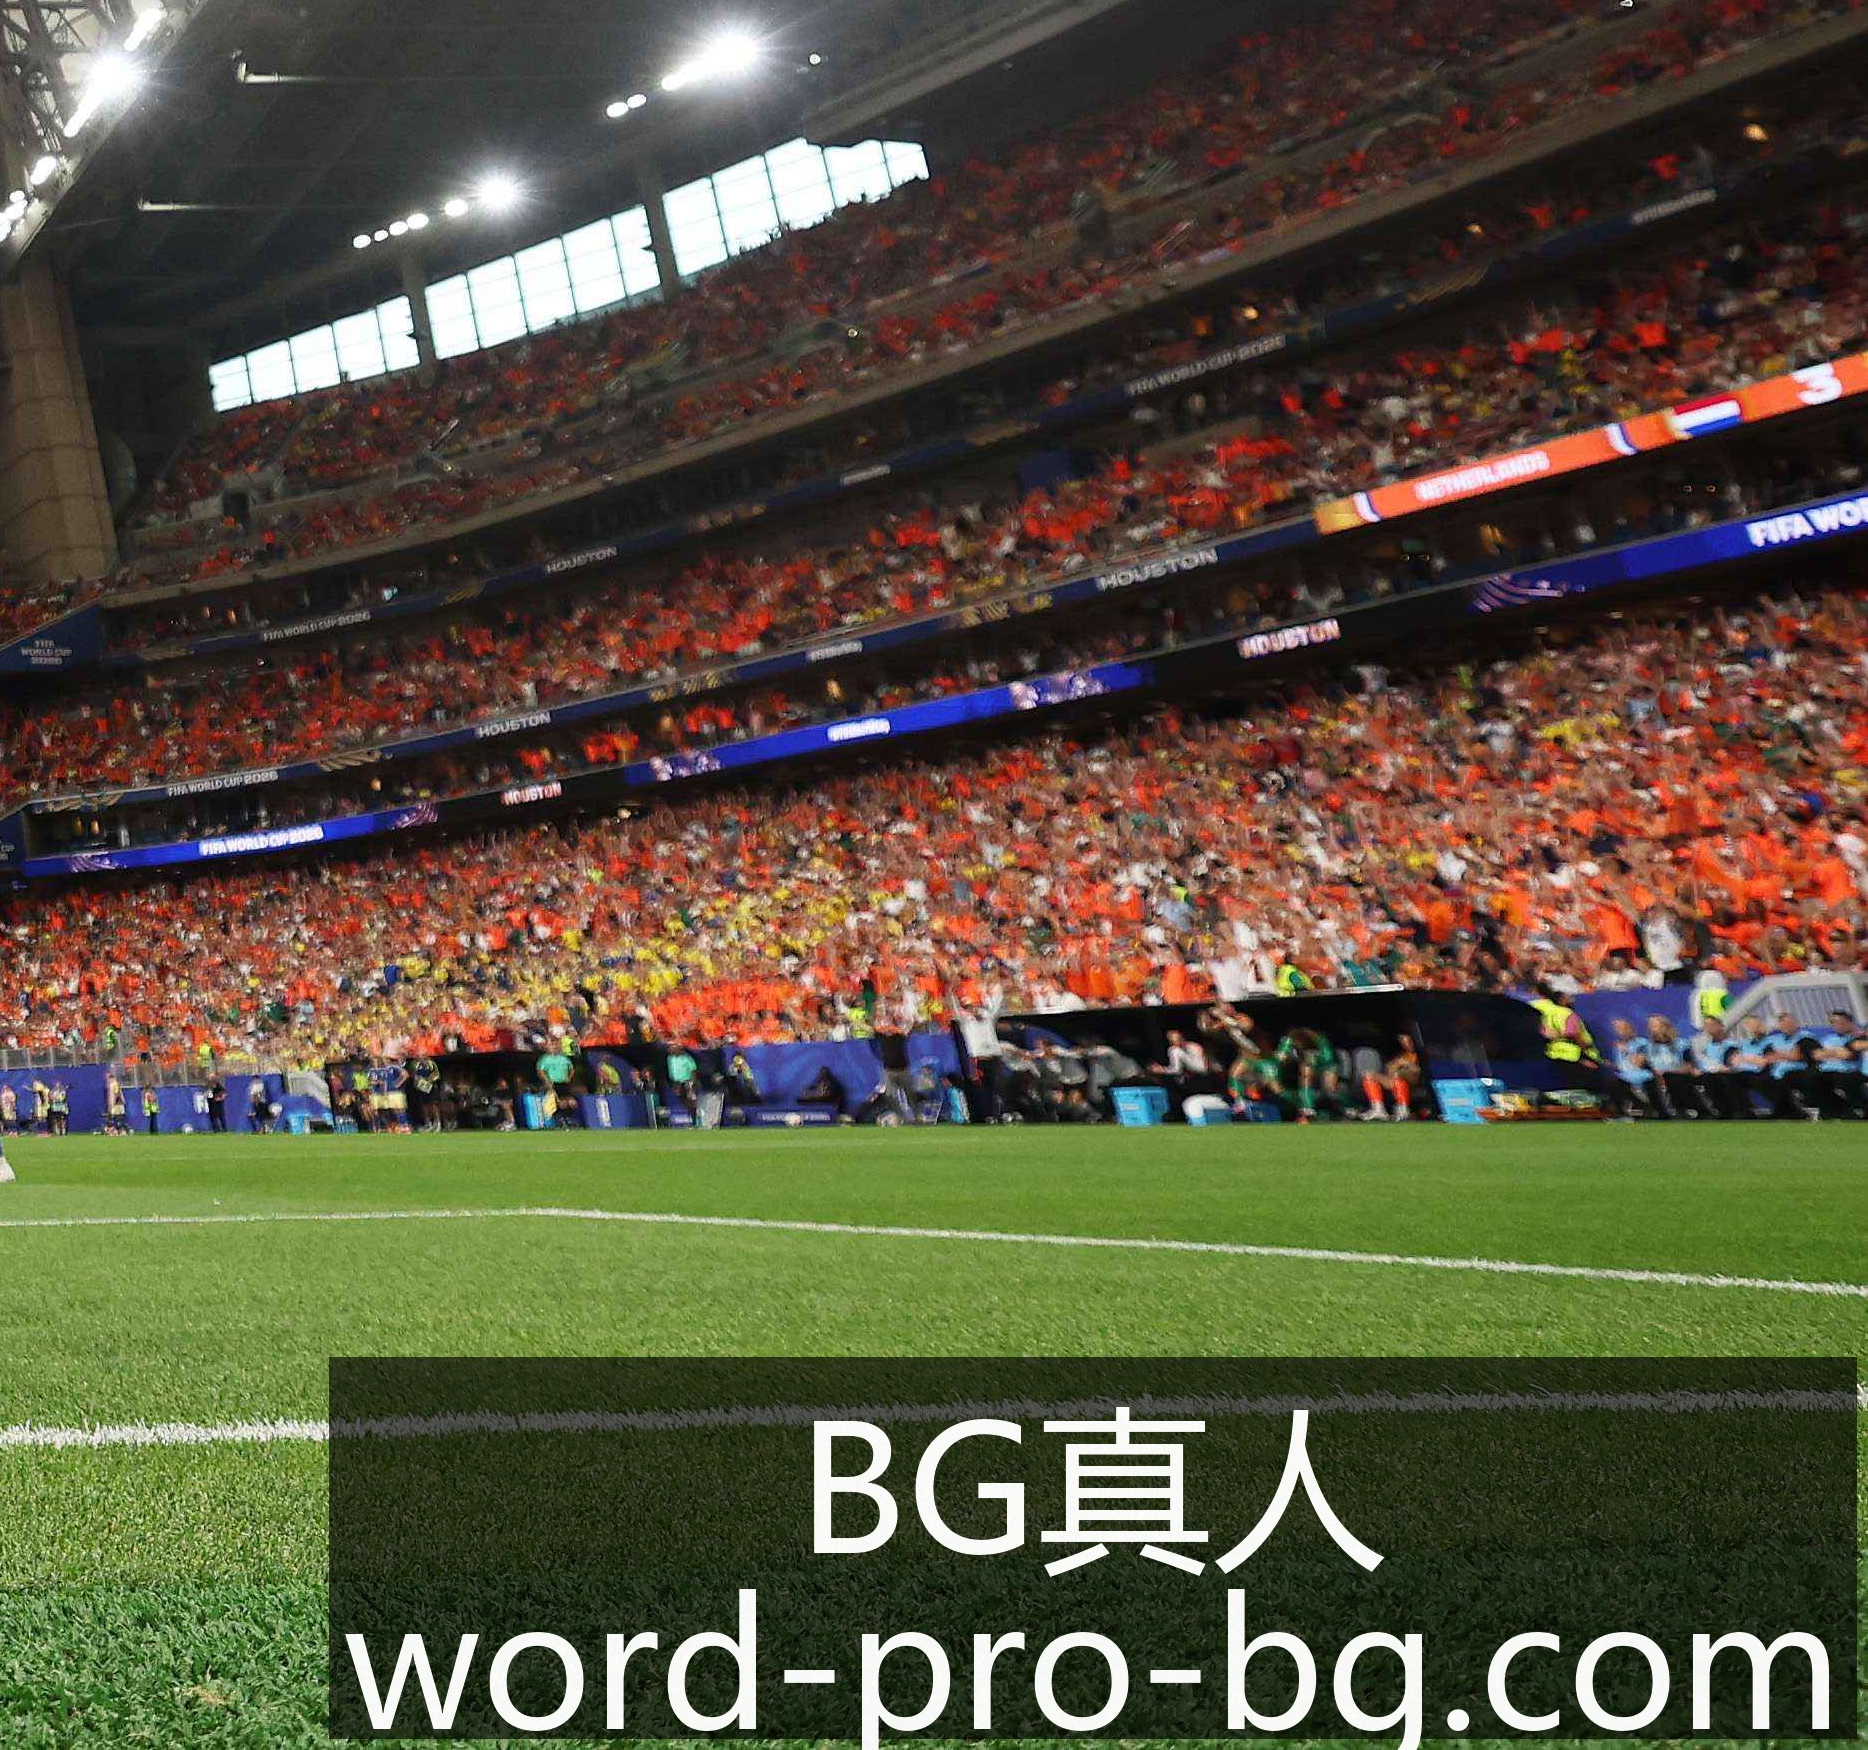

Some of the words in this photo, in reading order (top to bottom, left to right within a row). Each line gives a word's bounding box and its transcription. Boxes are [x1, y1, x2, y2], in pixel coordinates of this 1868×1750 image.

[1797, 361, 1843, 405] 3
[1413, 450, 1551, 501] NETHERLANDS
[1745, 512, 1816, 548] FIFA
[545, 547, 618, 573] HOUSTON
[1095, 547, 1217, 592] HOUSTON
[1237, 617, 1342, 659] HOUSTON
[475, 711, 552, 738] HOUSTON
[167, 782, 189, 797] FIFA
[189, 777, 222, 793] WORLD
[222, 774, 243, 790] CUP
[199, 838, 226, 856] FIFA
[226, 833, 264, 853] WORLD
[264, 829, 289, 847] CUP
